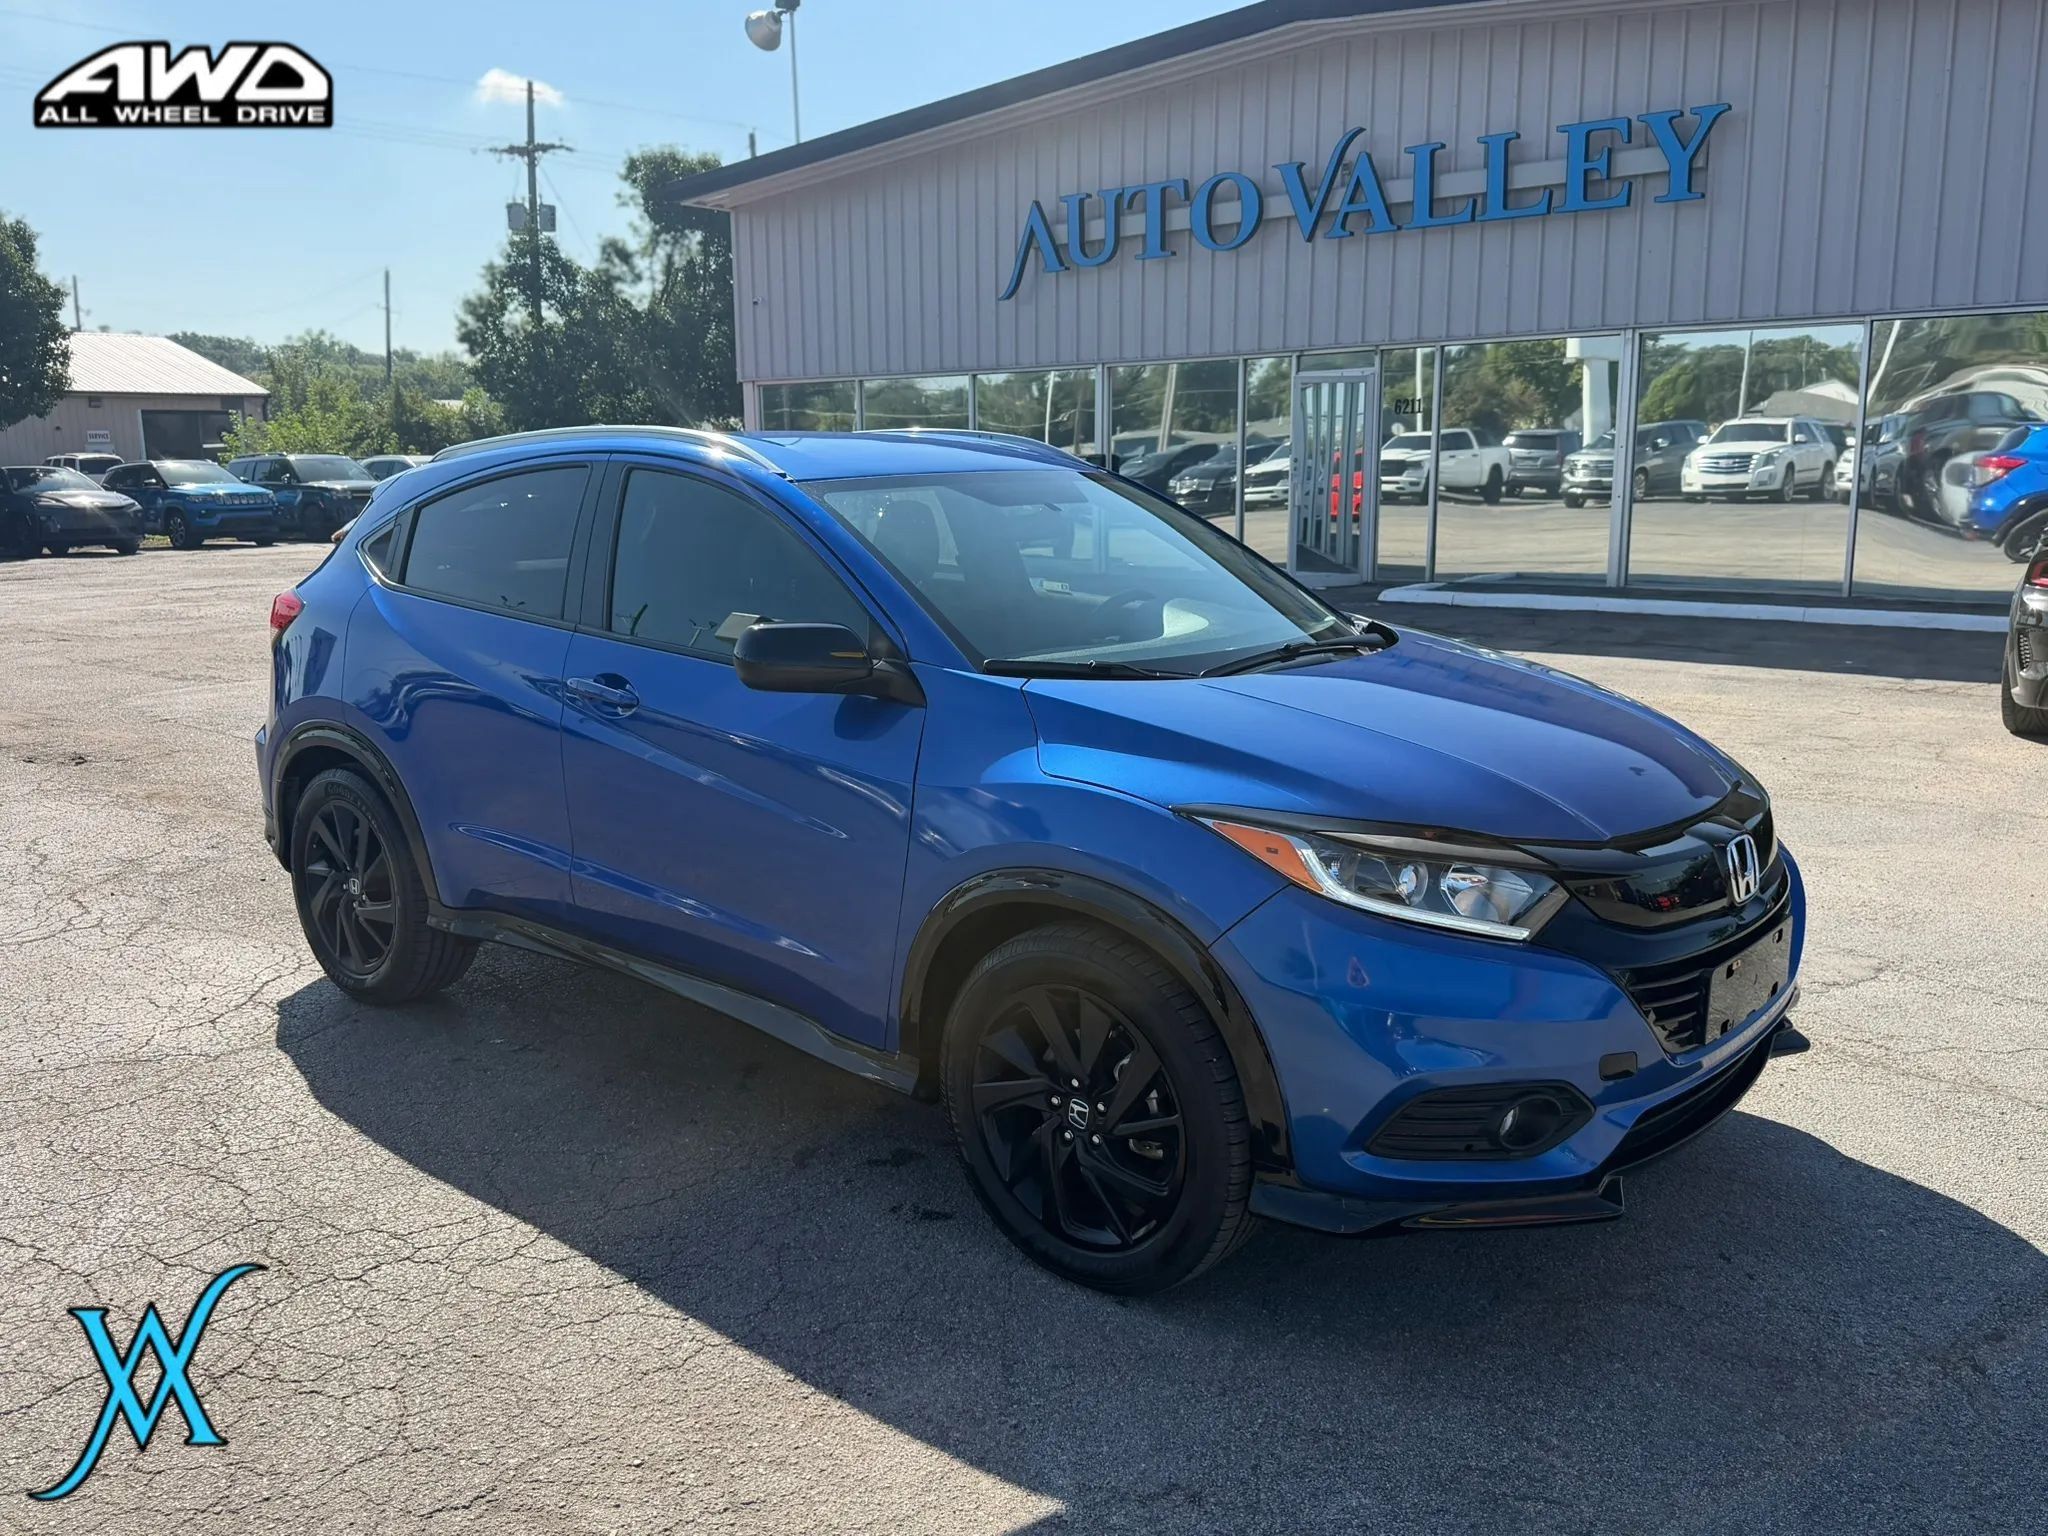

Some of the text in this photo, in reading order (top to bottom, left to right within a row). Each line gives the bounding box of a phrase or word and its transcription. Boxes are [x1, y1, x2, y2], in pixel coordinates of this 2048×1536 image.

[998, 103, 1732, 301] AUTO VALLEY
[1394, 399, 1422, 415] 6211
